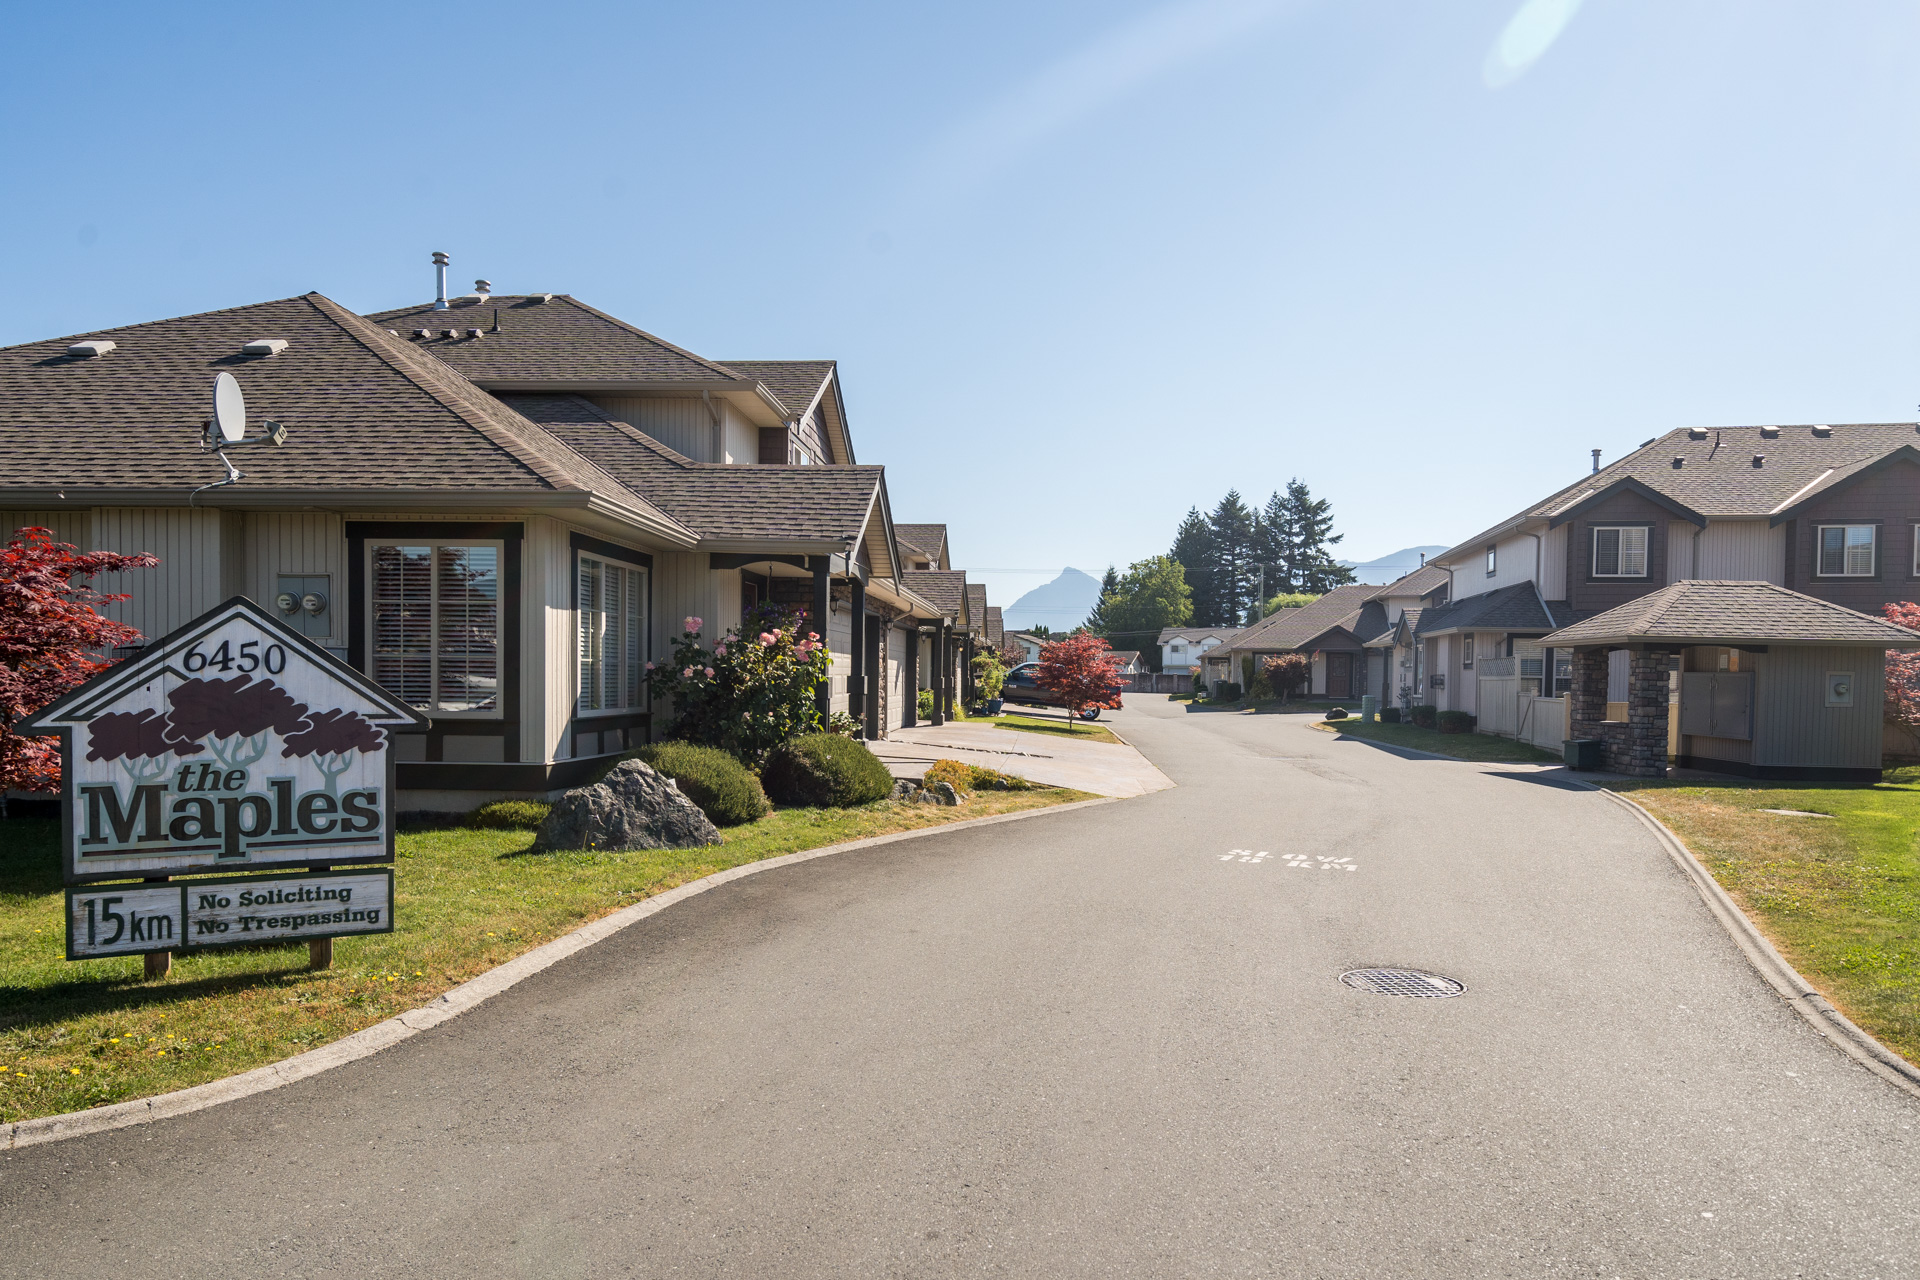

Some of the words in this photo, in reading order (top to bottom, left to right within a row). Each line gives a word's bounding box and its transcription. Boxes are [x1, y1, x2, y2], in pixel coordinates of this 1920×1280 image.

[182, 640, 287, 675] 6450
[177, 763, 246, 792] the
[81, 780, 380, 858] Maples
[198, 893, 231, 910] No
[239, 886, 353, 908] Soliciting
[197, 918, 229, 935] No
[238, 908, 381, 932] Trespassing
